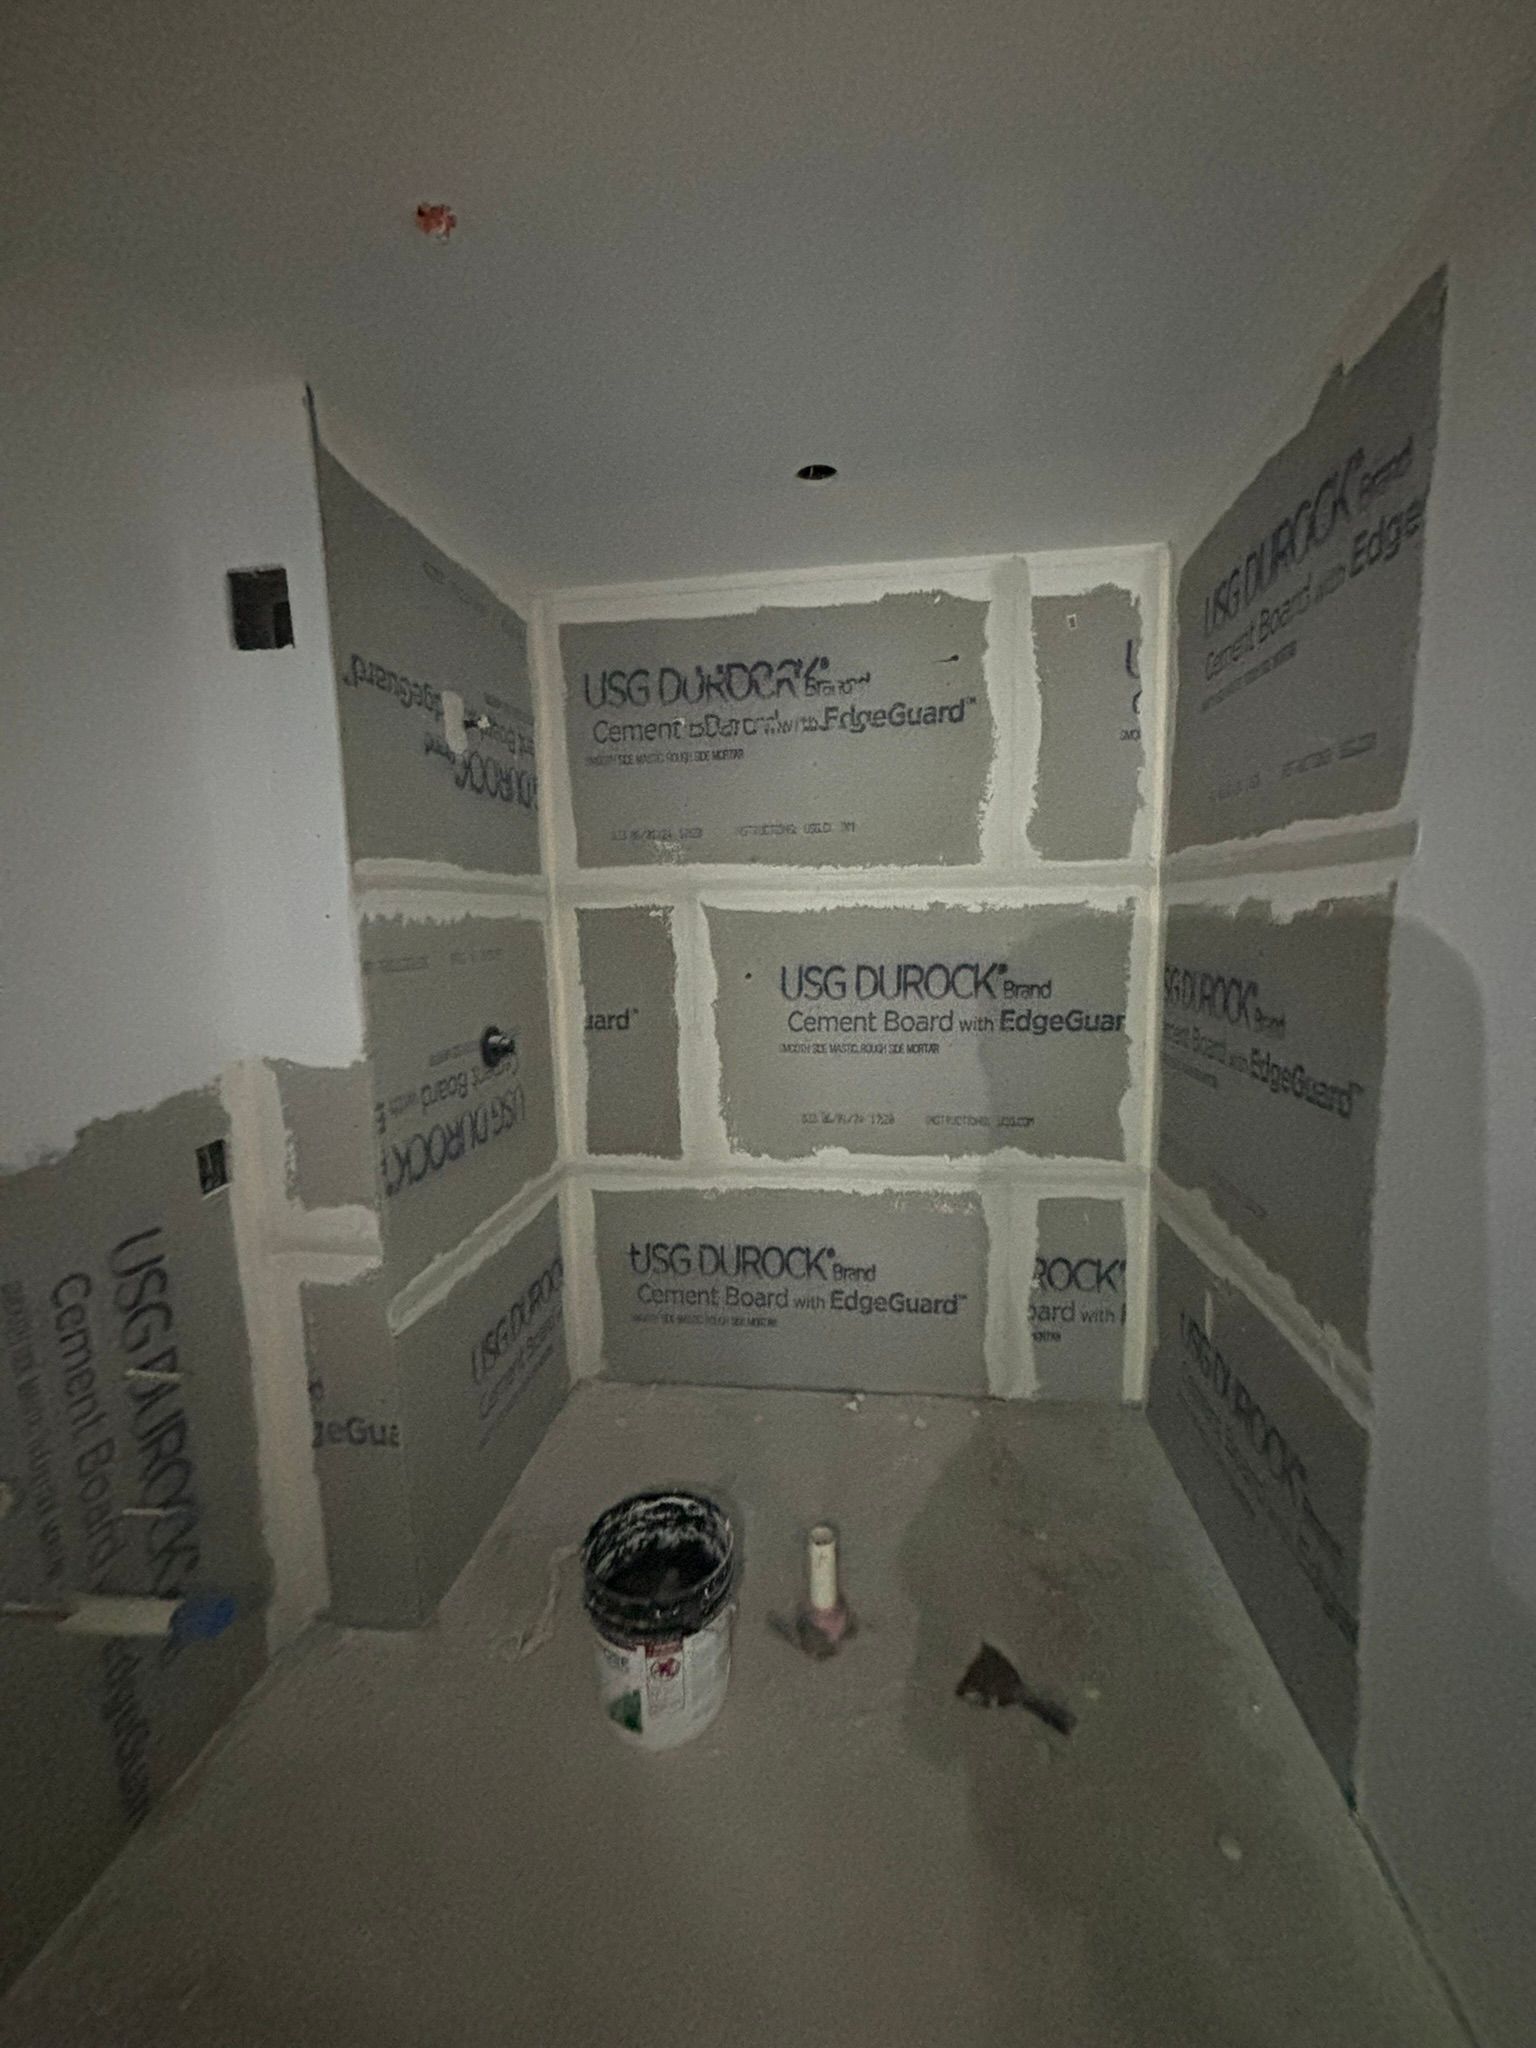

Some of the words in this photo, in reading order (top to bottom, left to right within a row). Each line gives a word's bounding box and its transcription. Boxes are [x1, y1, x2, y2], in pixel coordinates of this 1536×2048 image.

[584, 669, 650, 709] USG
[592, 713, 683, 745] Cement
[781, 964, 847, 1001] USG
[855, 962, 999, 1001] DUROCK
[1003, 980, 1052, 1000] Brand
[788, 1010, 877, 1033] Cement
[884, 1009, 955, 1033] Board
[959, 1016, 994, 1033] with
[629, 1242, 691, 1276] USG
[699, 1243, 828, 1281] DUROCK
[832, 1262, 876, 1282] Brand
[107, 1226, 174, 1354] USG
[637, 1282, 720, 1307] Cement
[724, 1285, 789, 1309] Board
[792, 1294, 827, 1311] with
[50, 1271, 108, 1440] Cement
